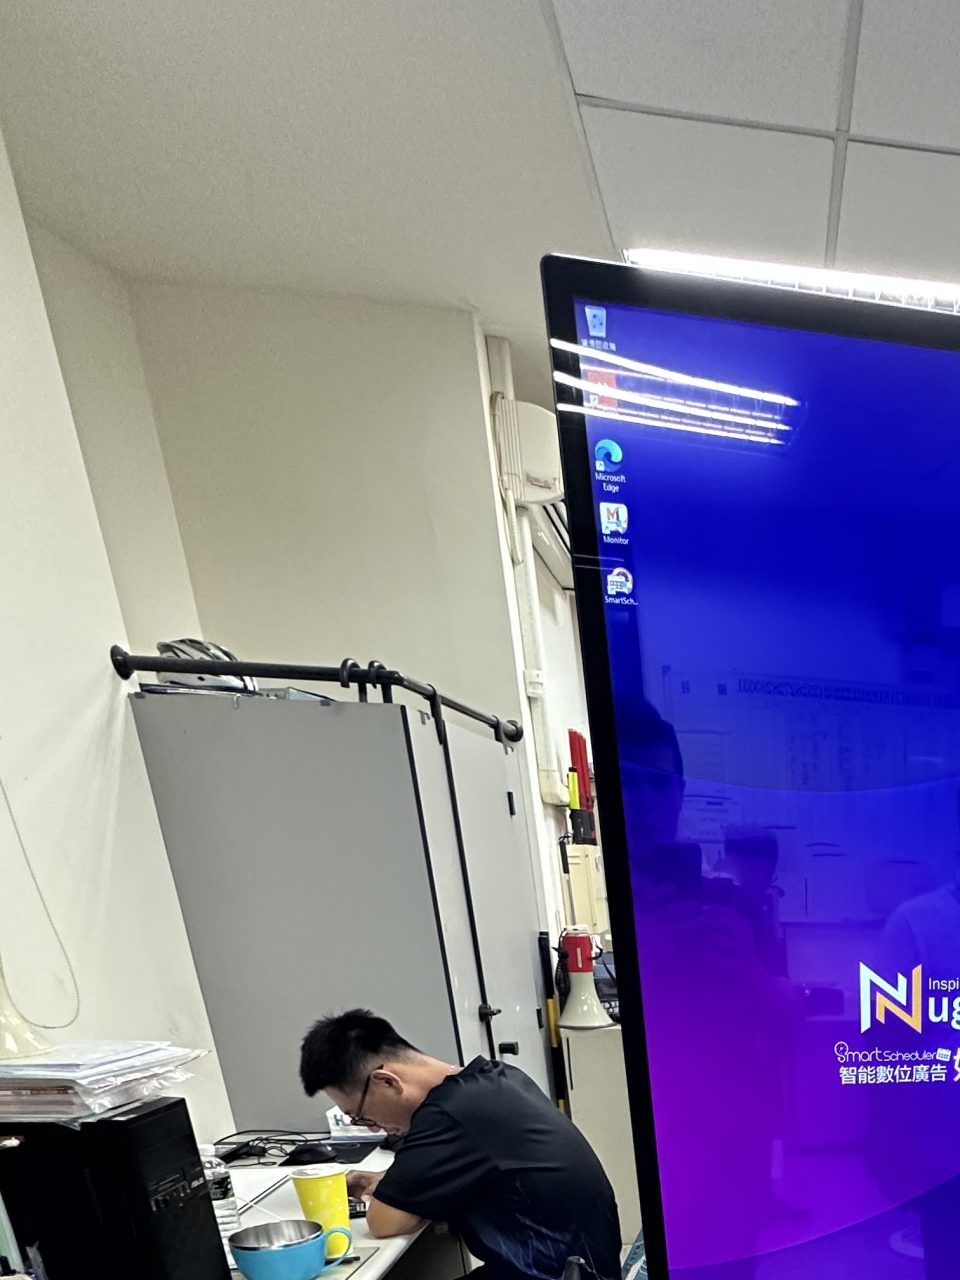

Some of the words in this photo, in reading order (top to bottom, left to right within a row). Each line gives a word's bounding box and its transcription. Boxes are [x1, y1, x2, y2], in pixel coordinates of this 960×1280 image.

[595, 472, 626, 483] Microsoft
[603, 483, 620, 493] Edge
[603, 535, 629, 545] Monitor
[839, 1064, 947, 1085] 智能數位廣告
